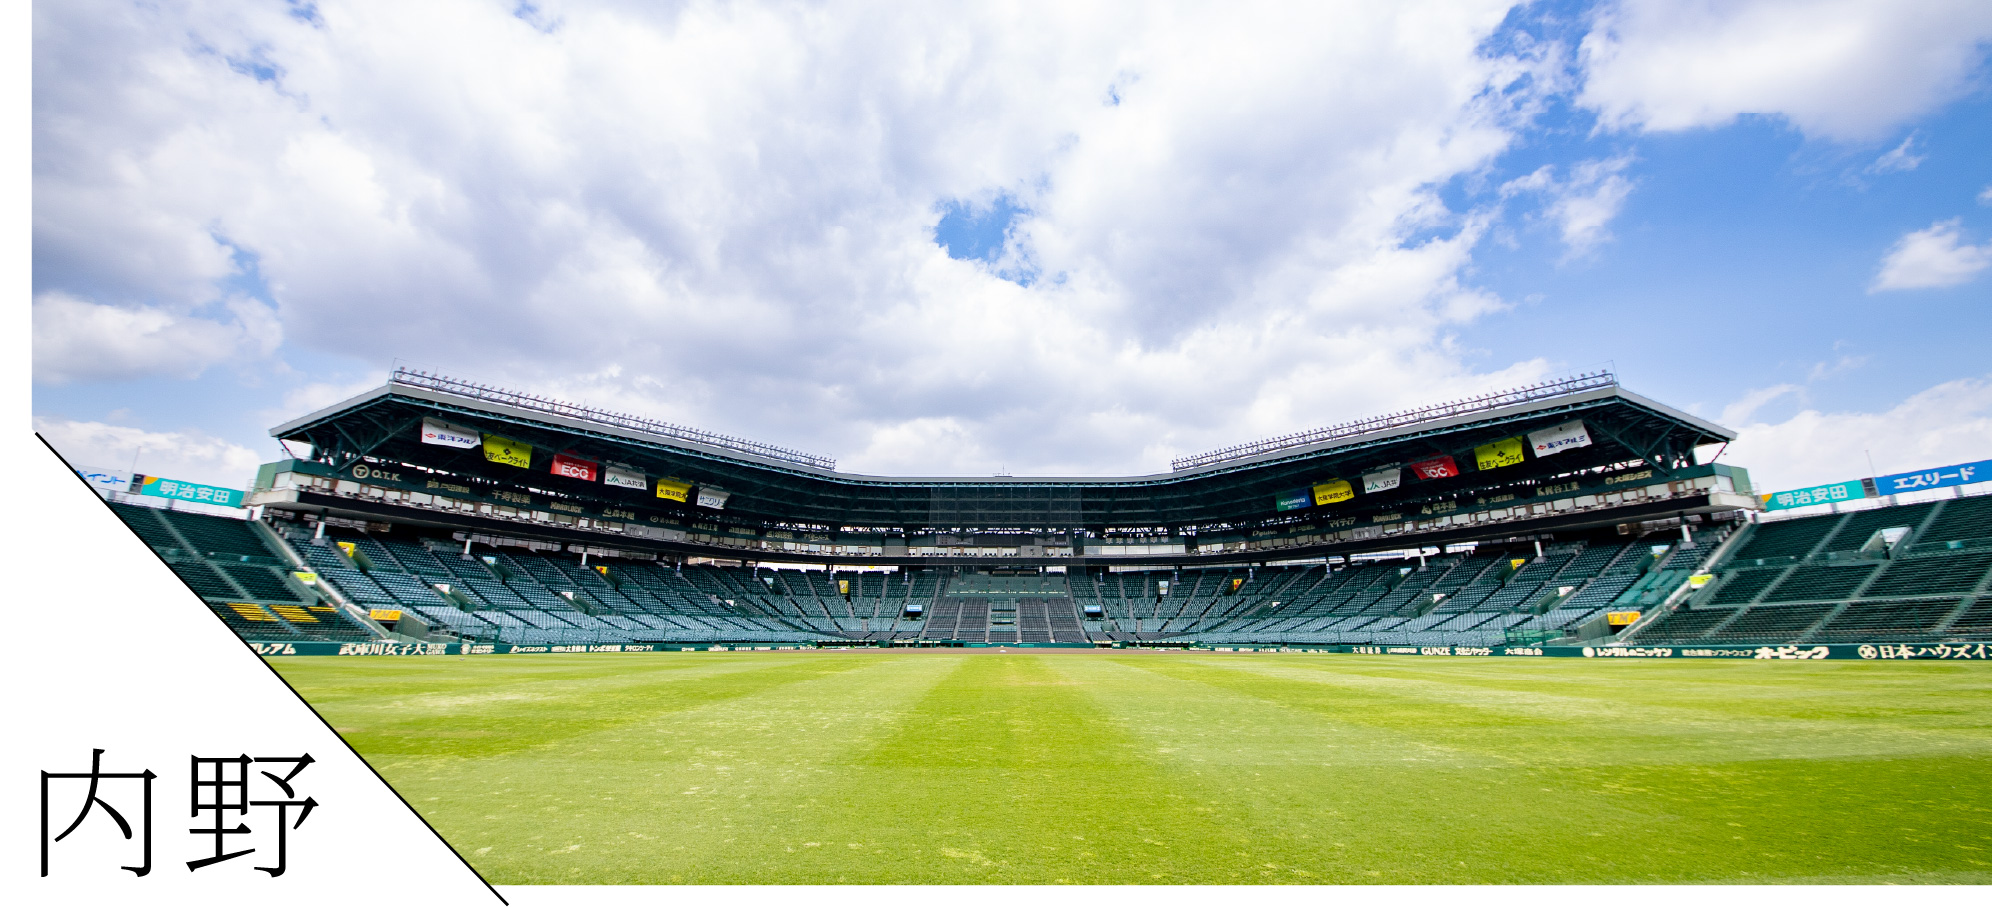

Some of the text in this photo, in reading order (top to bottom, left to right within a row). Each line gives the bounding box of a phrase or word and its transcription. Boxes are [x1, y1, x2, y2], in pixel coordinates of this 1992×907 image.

[561, 465, 589, 480] ECC
[1893, 466, 1976, 490] エスリード
[159, 481, 230, 503] 明治安田
[1776, 485, 1848, 507] 明治安田
[338, 643, 426, 656] 武庫川女子大
[1421, 647, 1451, 656] GUNZE
[1596, 647, 1673, 657] レンタルのニッケン
[1755, 645, 1830, 660] オービック
[1879, 644, 1992, 659] 日本ハウズイ
